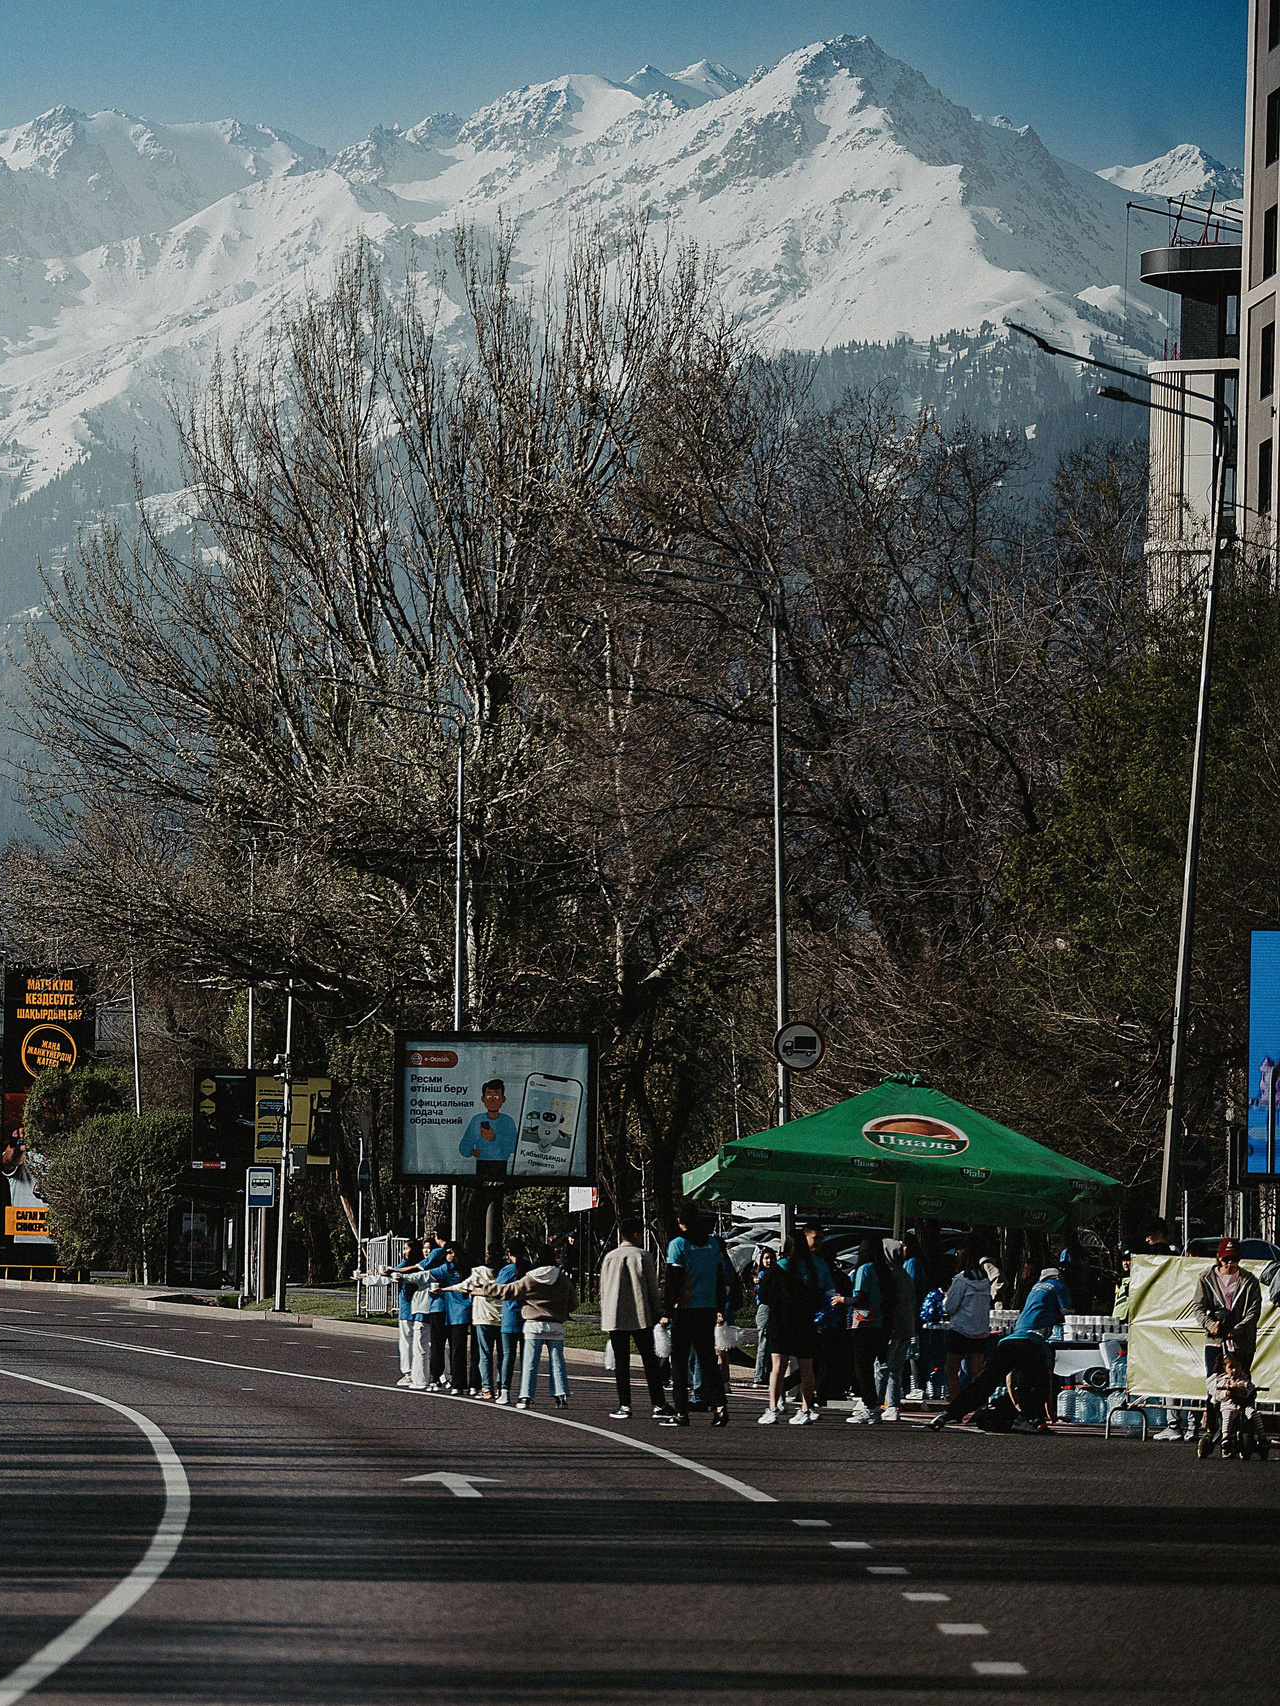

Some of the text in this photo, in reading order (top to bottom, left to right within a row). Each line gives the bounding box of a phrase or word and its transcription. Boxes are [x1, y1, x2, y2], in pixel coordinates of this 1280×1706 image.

[25, 993, 75, 1006] КЕЗДЕСУГЕ
[67, 1010, 83, 1020] БА?
[410, 1074, 443, 1084] Ресми
[410, 1084, 468, 1096] өтініш беру
[409, 1098, 475, 1108] Официальная
[410, 1108, 443, 1117] подача
[410, 1116, 463, 1126] обращений
[878, 1134, 958, 1151] Пиала
[520, 1149, 567, 1163] Қабылданды
[963, 1168, 986, 1178] Piala
